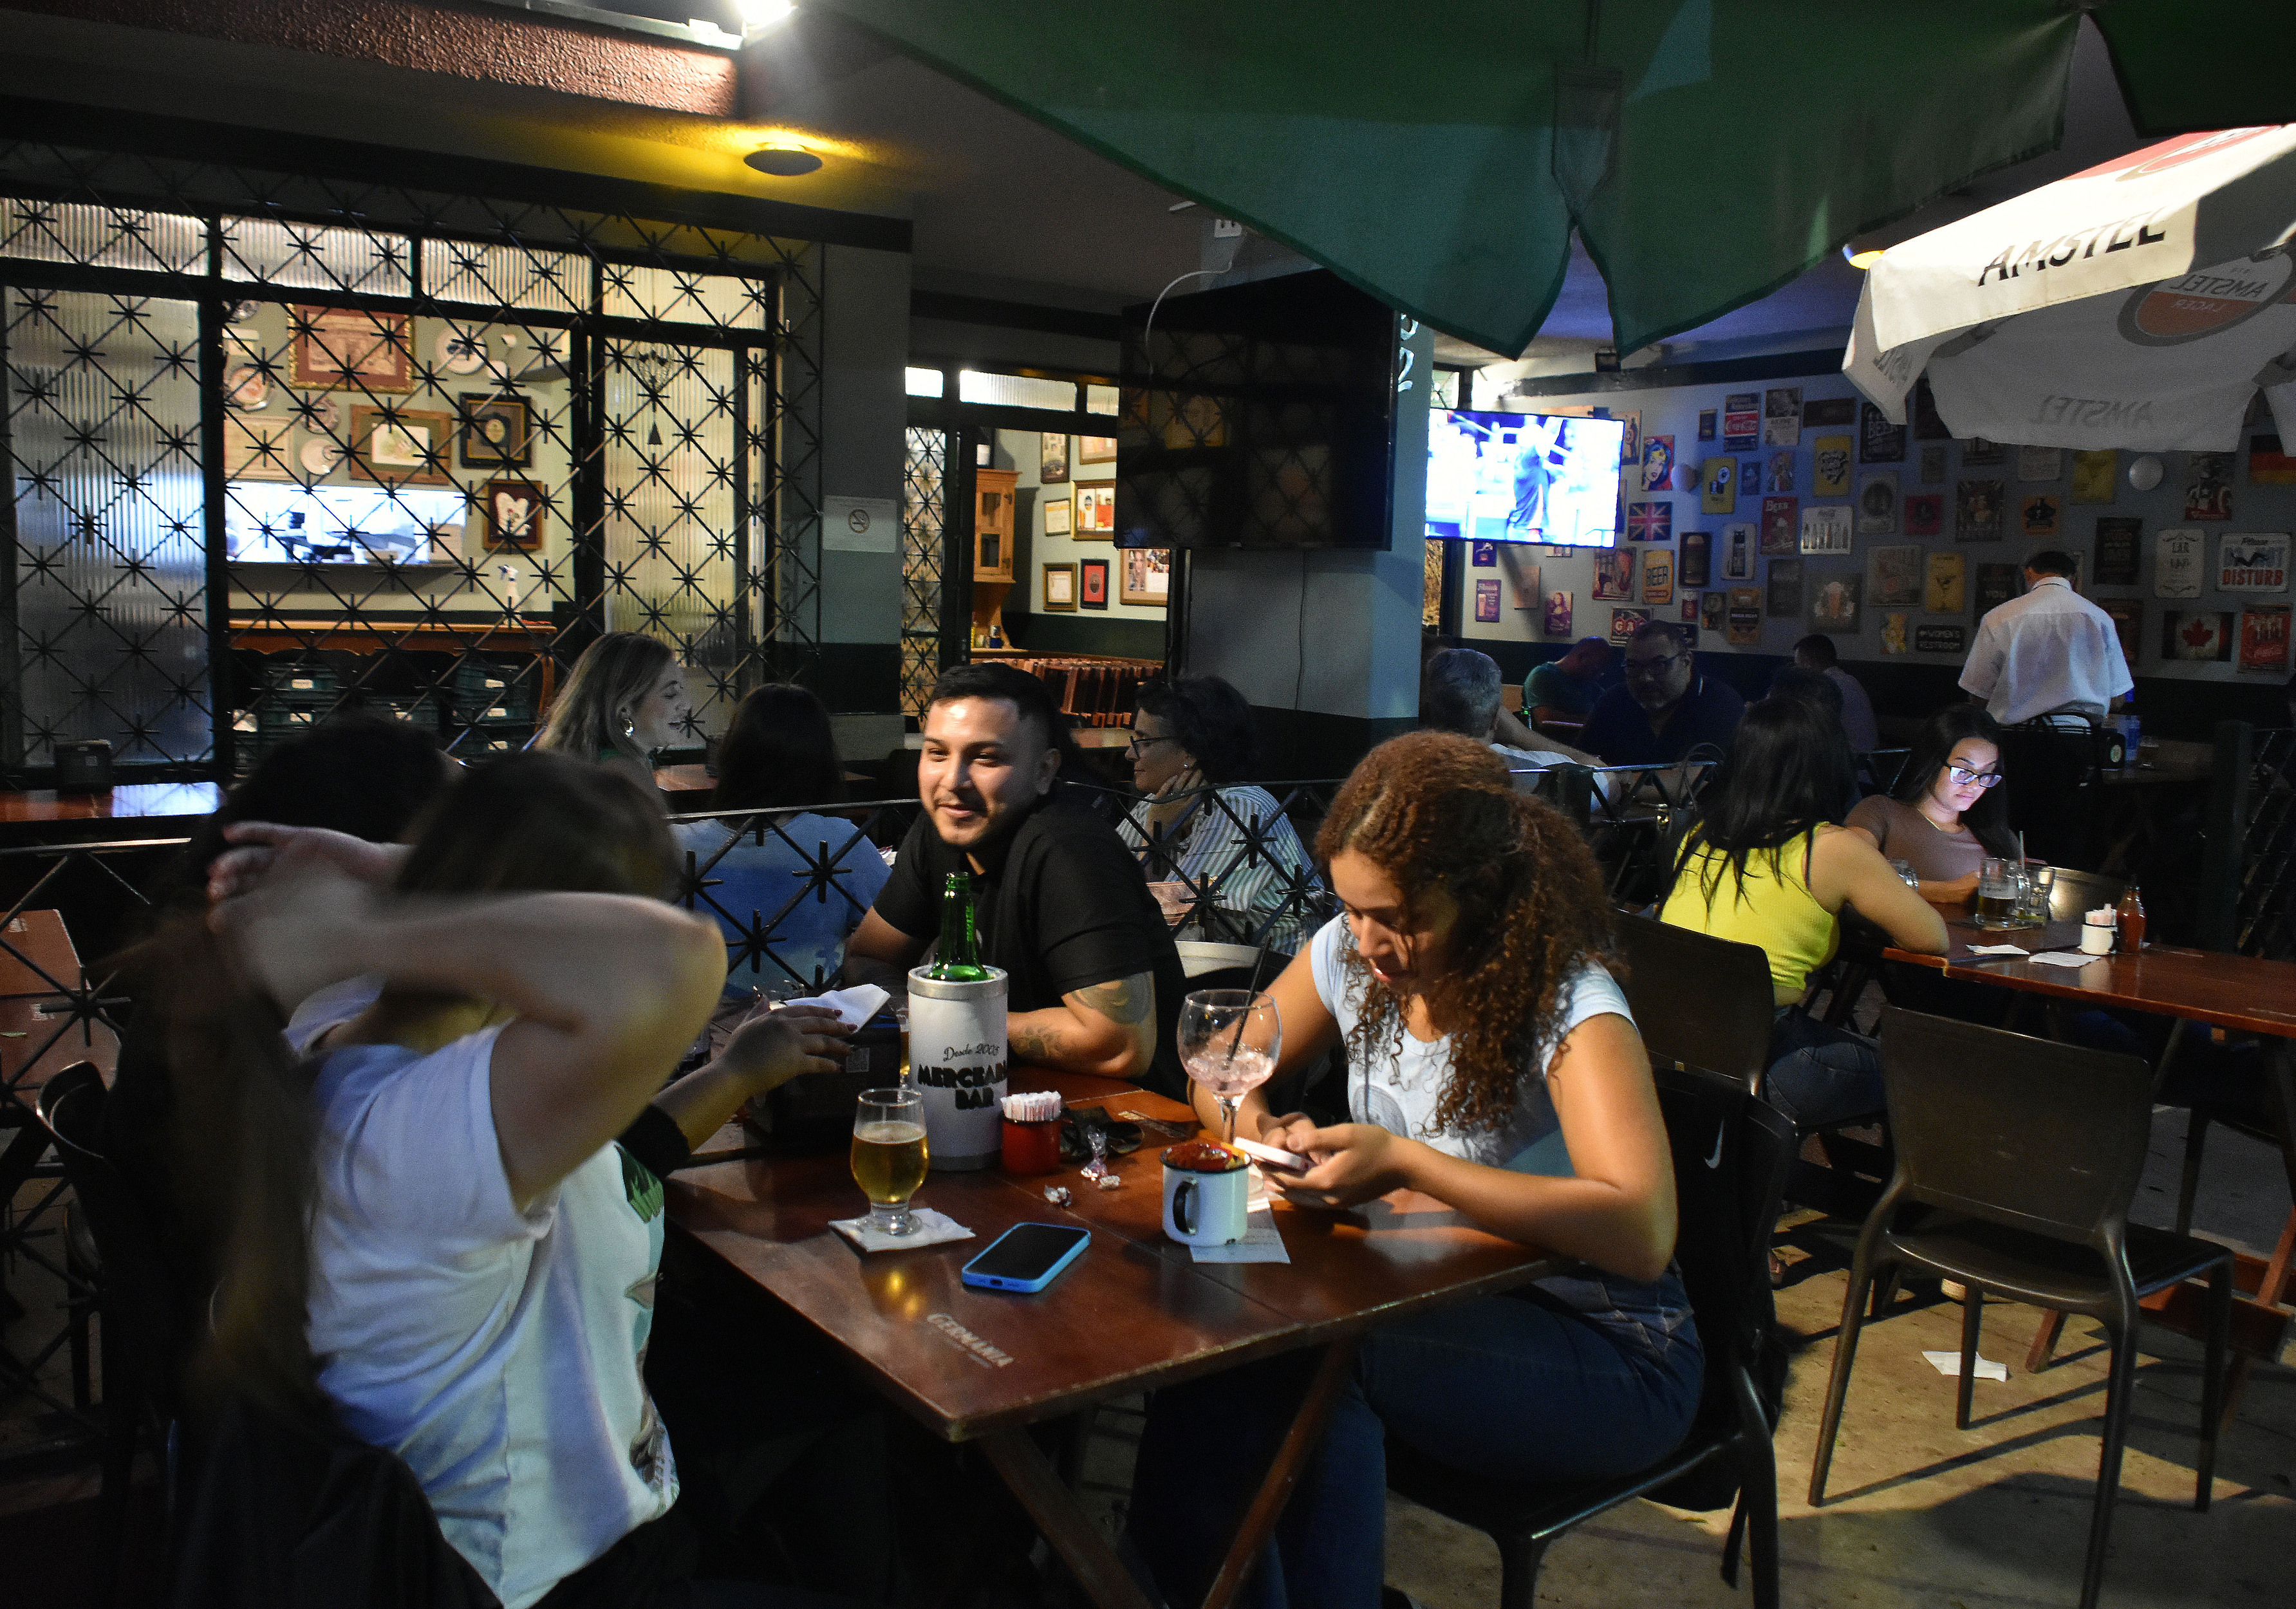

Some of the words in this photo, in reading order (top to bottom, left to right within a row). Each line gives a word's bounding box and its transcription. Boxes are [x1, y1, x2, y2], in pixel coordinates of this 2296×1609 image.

[1978, 209, 2165, 286] AMSTEL
[1647, 565, 1669, 587] BEER
[2223, 569, 2283, 586] DISTURB
[943, 1043, 973, 1061] Desde
[955, 1088, 994, 1110] BAR
